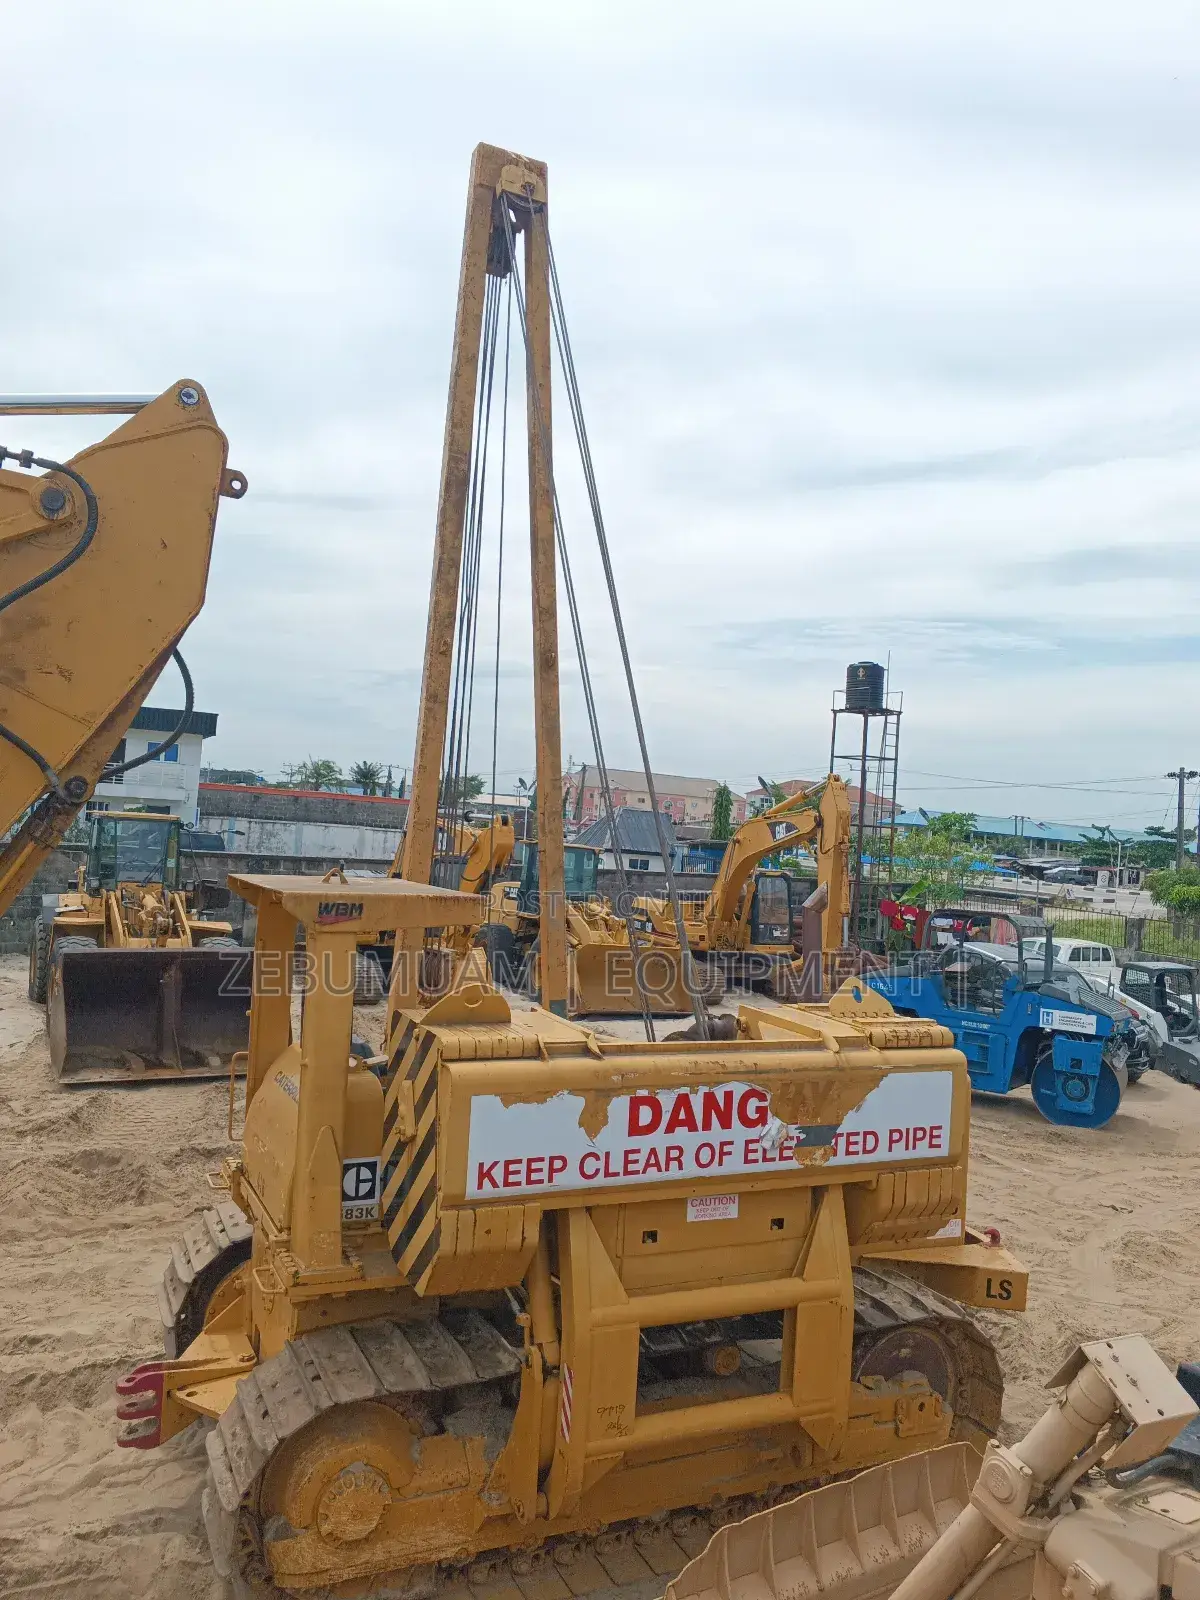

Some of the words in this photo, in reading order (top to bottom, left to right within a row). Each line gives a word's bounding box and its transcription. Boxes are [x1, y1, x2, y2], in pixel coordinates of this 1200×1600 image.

[775, 822, 787, 840] CAT
[317, 902, 364, 918] WBM
[627, 1088, 797, 1138] DANG
[477, 1155, 568, 1190] KEEP
[578, 1144, 684, 1181] CLEAR
[694, 1140, 734, 1169] OF
[743, 1130, 880, 1165] ELETED
[887, 1125, 943, 1153] PIPE
[690, 1196, 736, 1208] CAUTION
[342, 1207, 375, 1220] 83K
[985, 1277, 1014, 1301] LS
